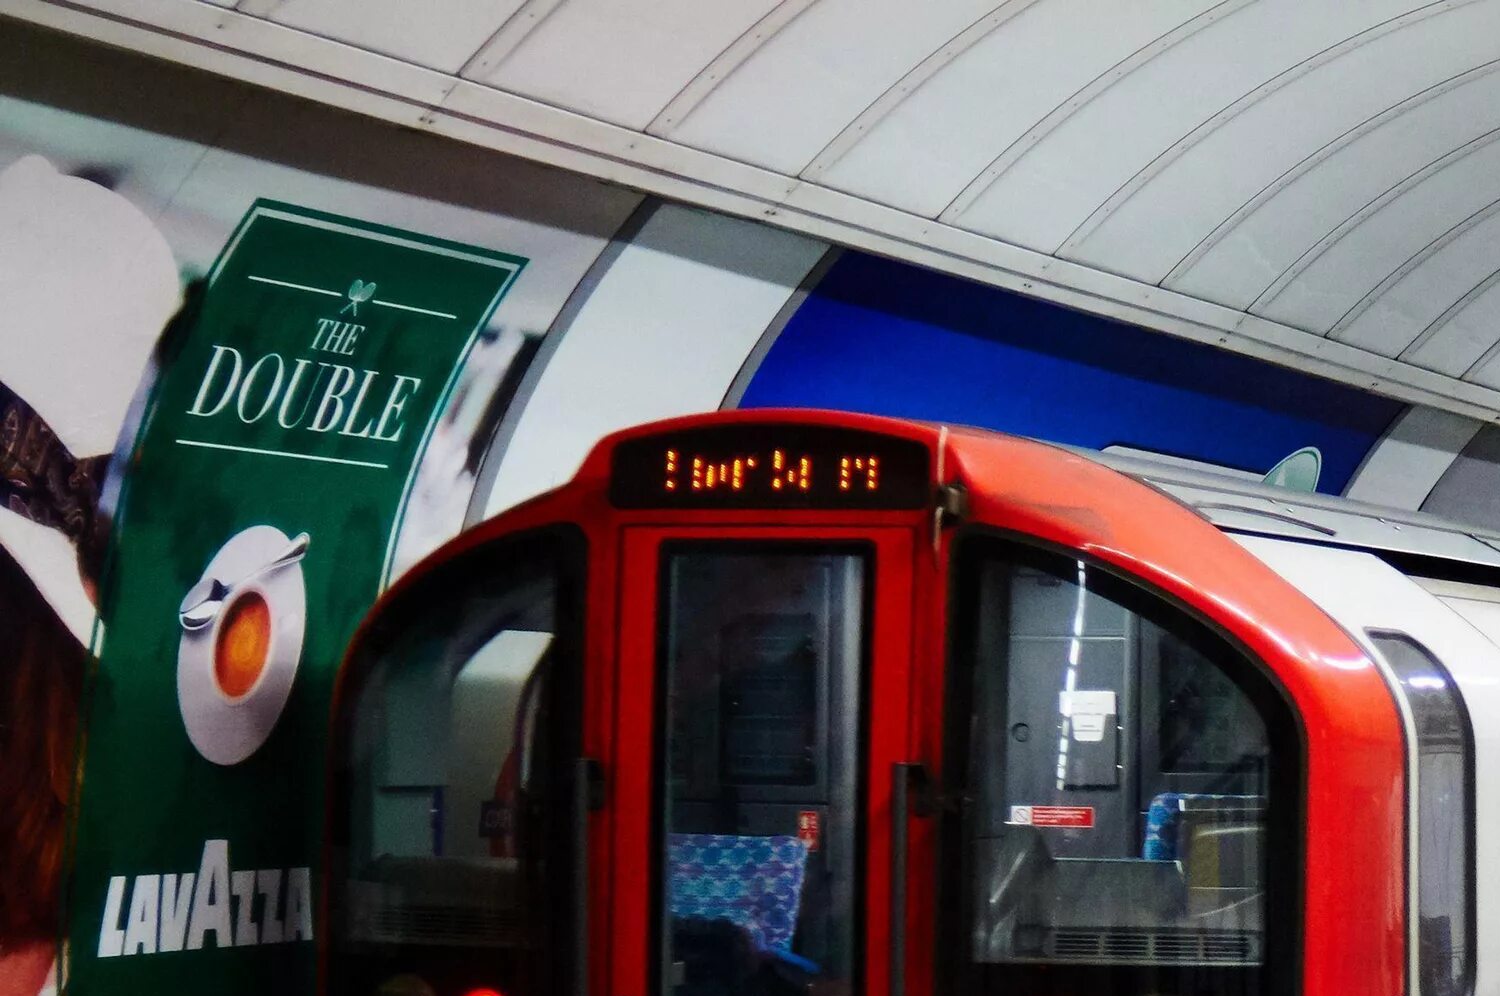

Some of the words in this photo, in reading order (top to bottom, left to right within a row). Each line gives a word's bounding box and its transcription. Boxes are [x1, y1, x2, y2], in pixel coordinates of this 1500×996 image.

[311, 318, 365, 356] THE
[185, 344, 422, 442] DOUBLE
[97, 839, 314, 958] LAVAZZA
